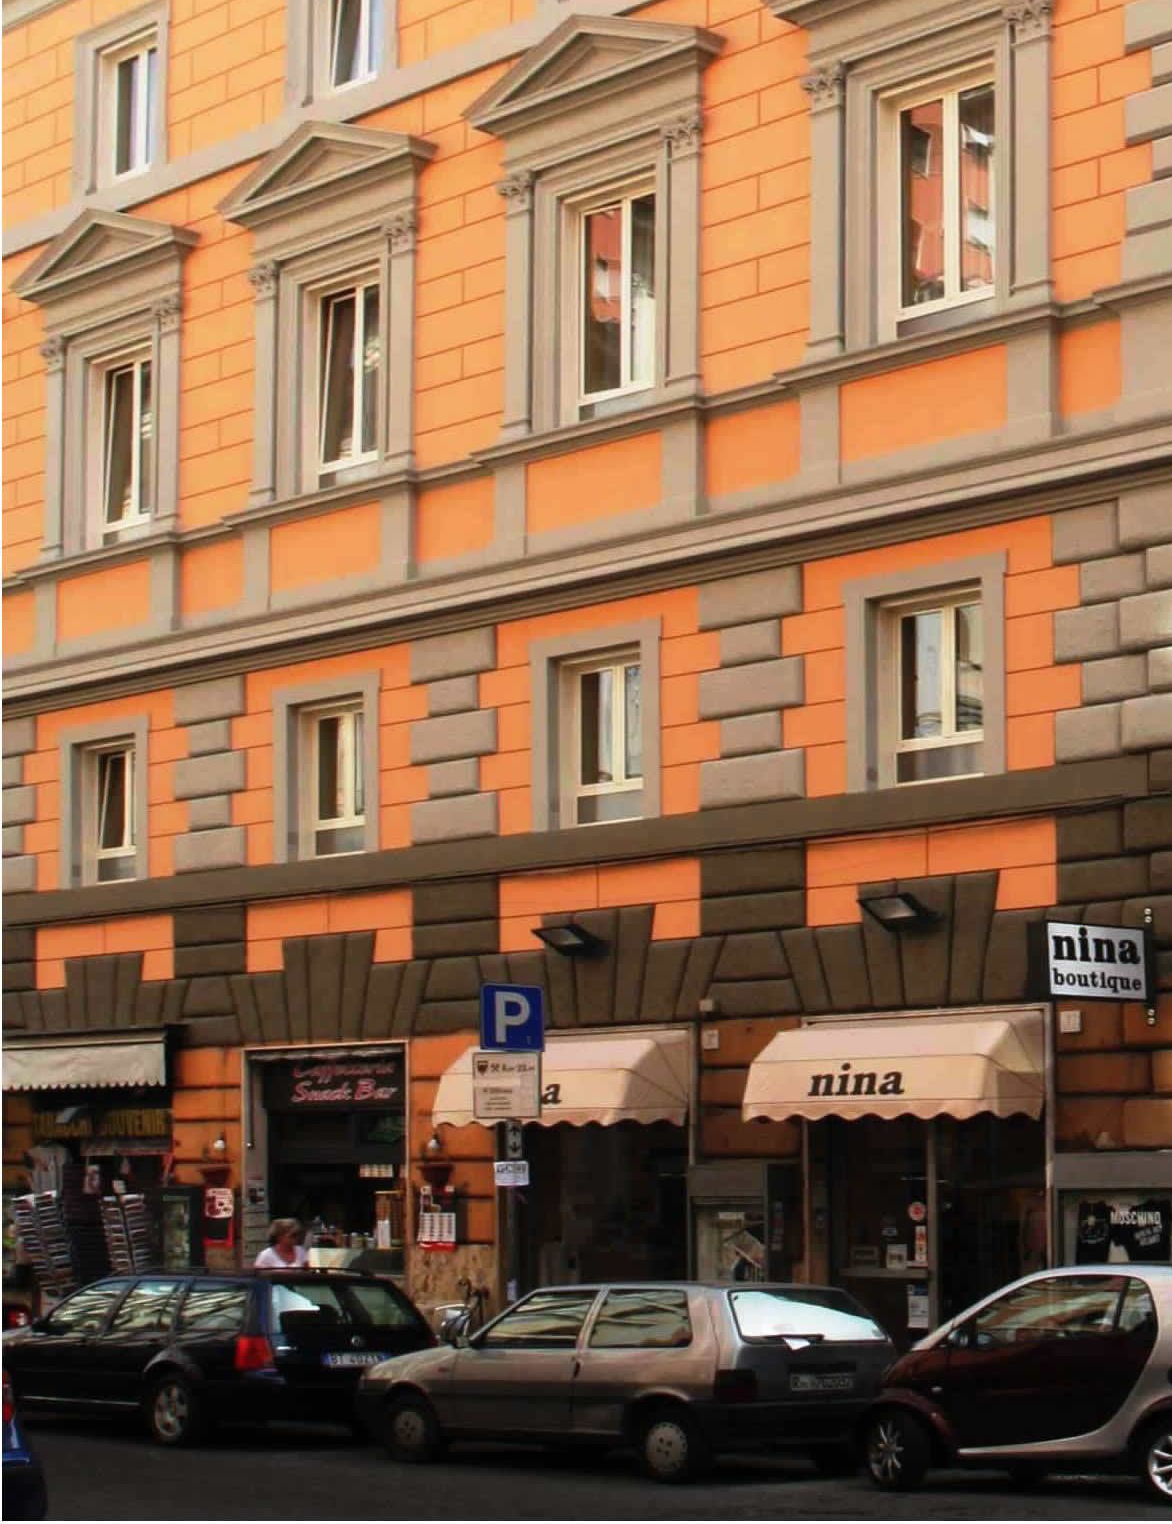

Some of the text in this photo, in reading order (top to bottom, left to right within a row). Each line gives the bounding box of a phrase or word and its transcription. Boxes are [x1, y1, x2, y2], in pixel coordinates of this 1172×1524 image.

[1052, 927, 1140, 964] nina
[1053, 968, 1142, 993] boutique
[495, 991, 530, 1043] P
[291, 1078, 397, 1103] Snack Bar
[808, 1063, 904, 1096] nina
